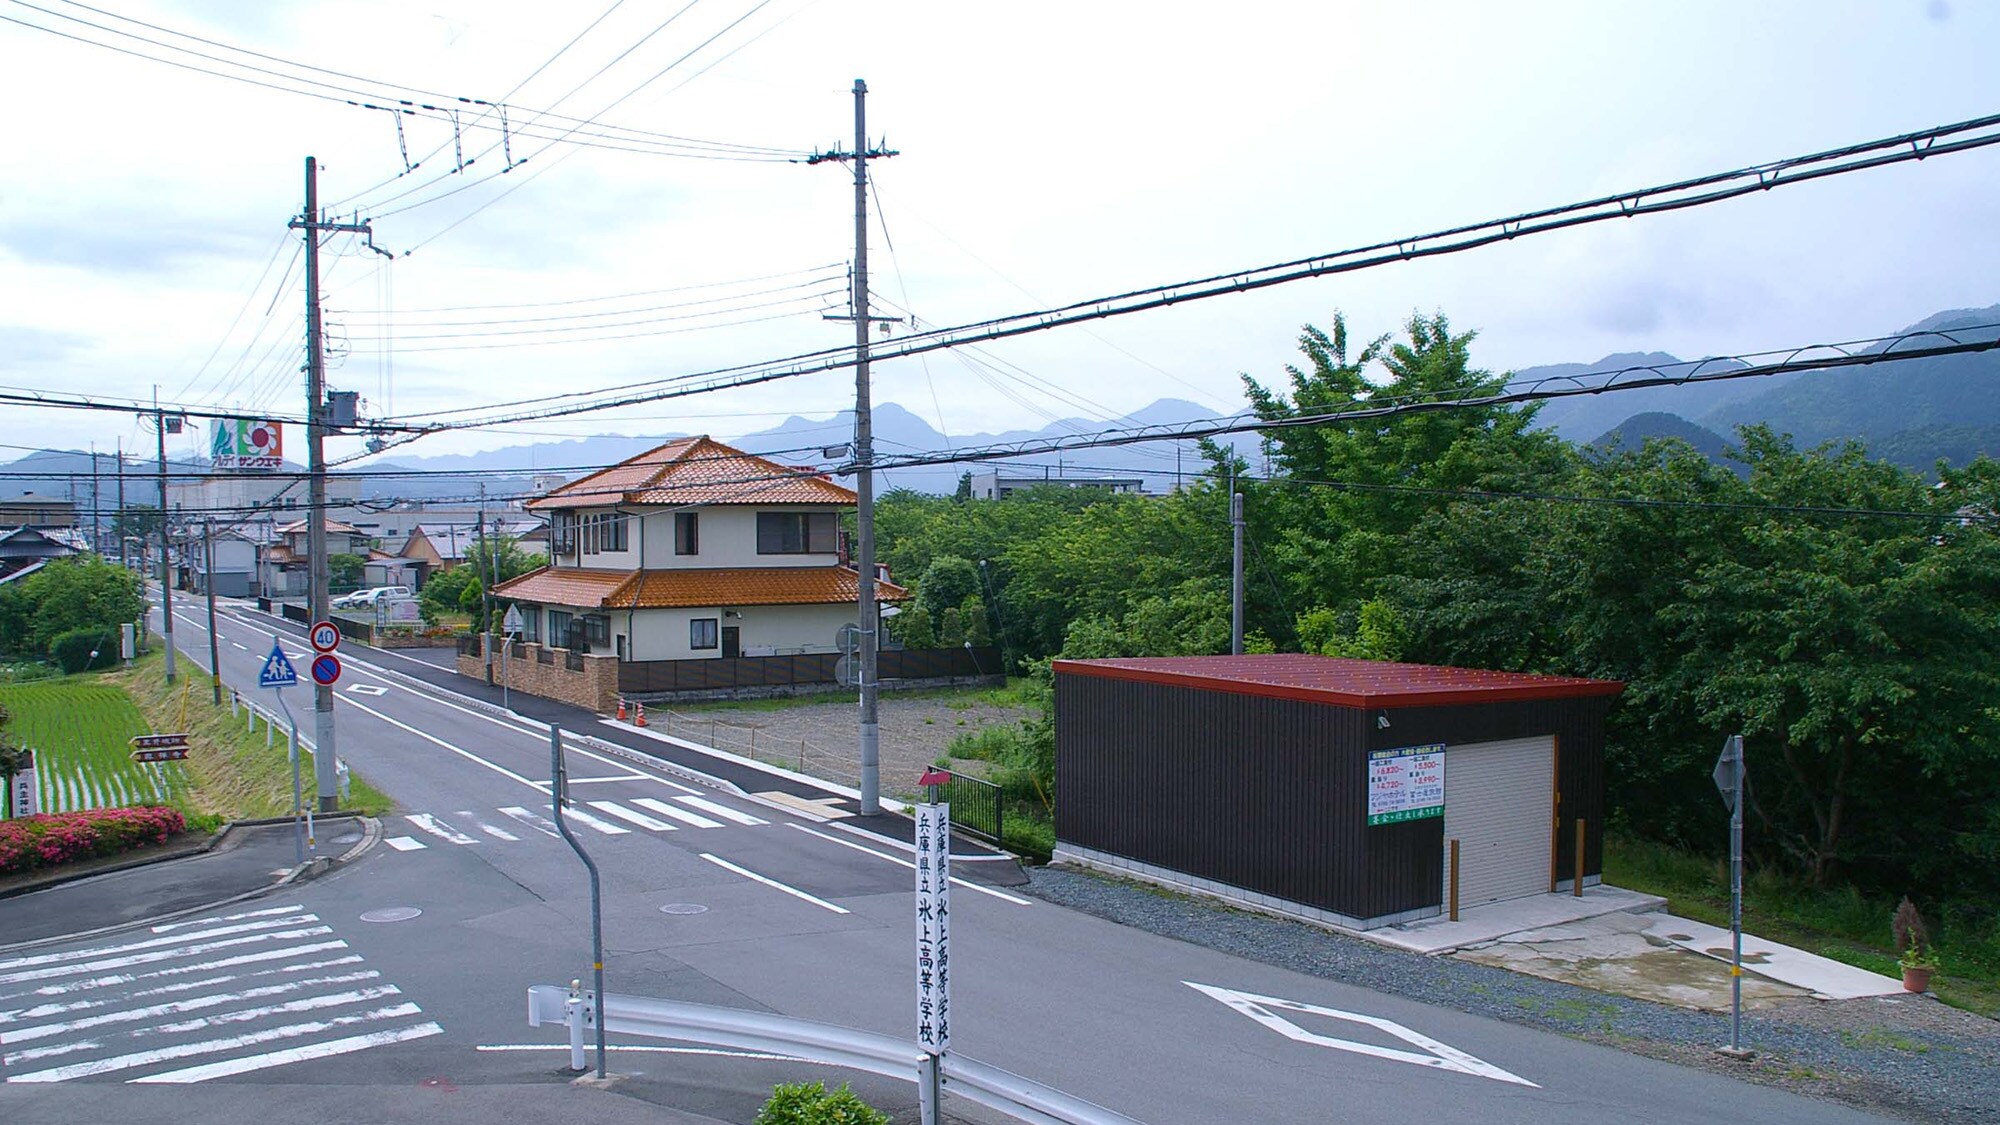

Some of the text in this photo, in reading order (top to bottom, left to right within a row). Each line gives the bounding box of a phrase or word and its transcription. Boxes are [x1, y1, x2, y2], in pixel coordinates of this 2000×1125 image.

[239, 456, 282, 467] サンウエキ
[317, 630, 333, 644] 40
[918, 813, 934, 1046] 兵庫県立氷上高等学校
[937, 813, 949, 1046] 兵庫県立氷上高等学校
